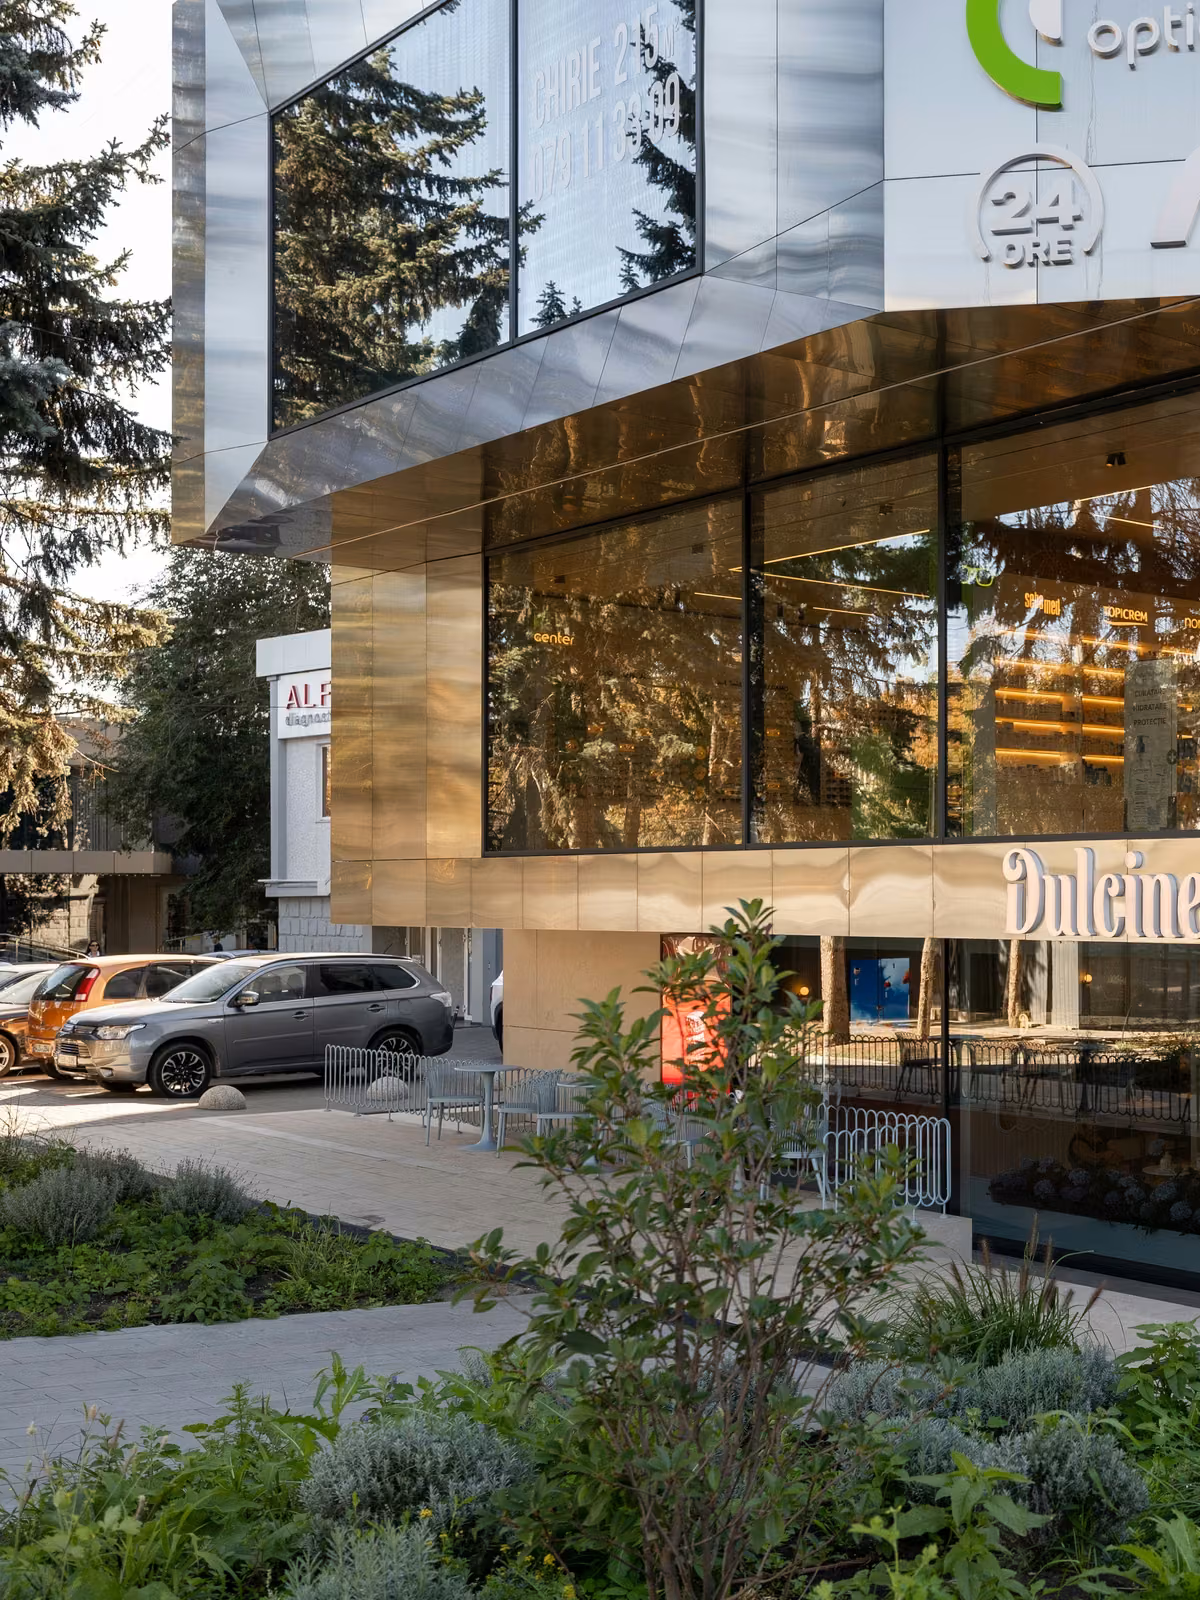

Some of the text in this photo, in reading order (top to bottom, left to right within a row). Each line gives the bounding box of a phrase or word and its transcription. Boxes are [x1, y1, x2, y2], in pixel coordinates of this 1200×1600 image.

[533, 36, 601, 129] CHIRIE
[613, 4, 660, 86] 215
[528, 129, 572, 202] 079
[989, 175, 1083, 236] 24
[1000, 237, 1074, 269] ORE
[533, 632, 575, 646] center
